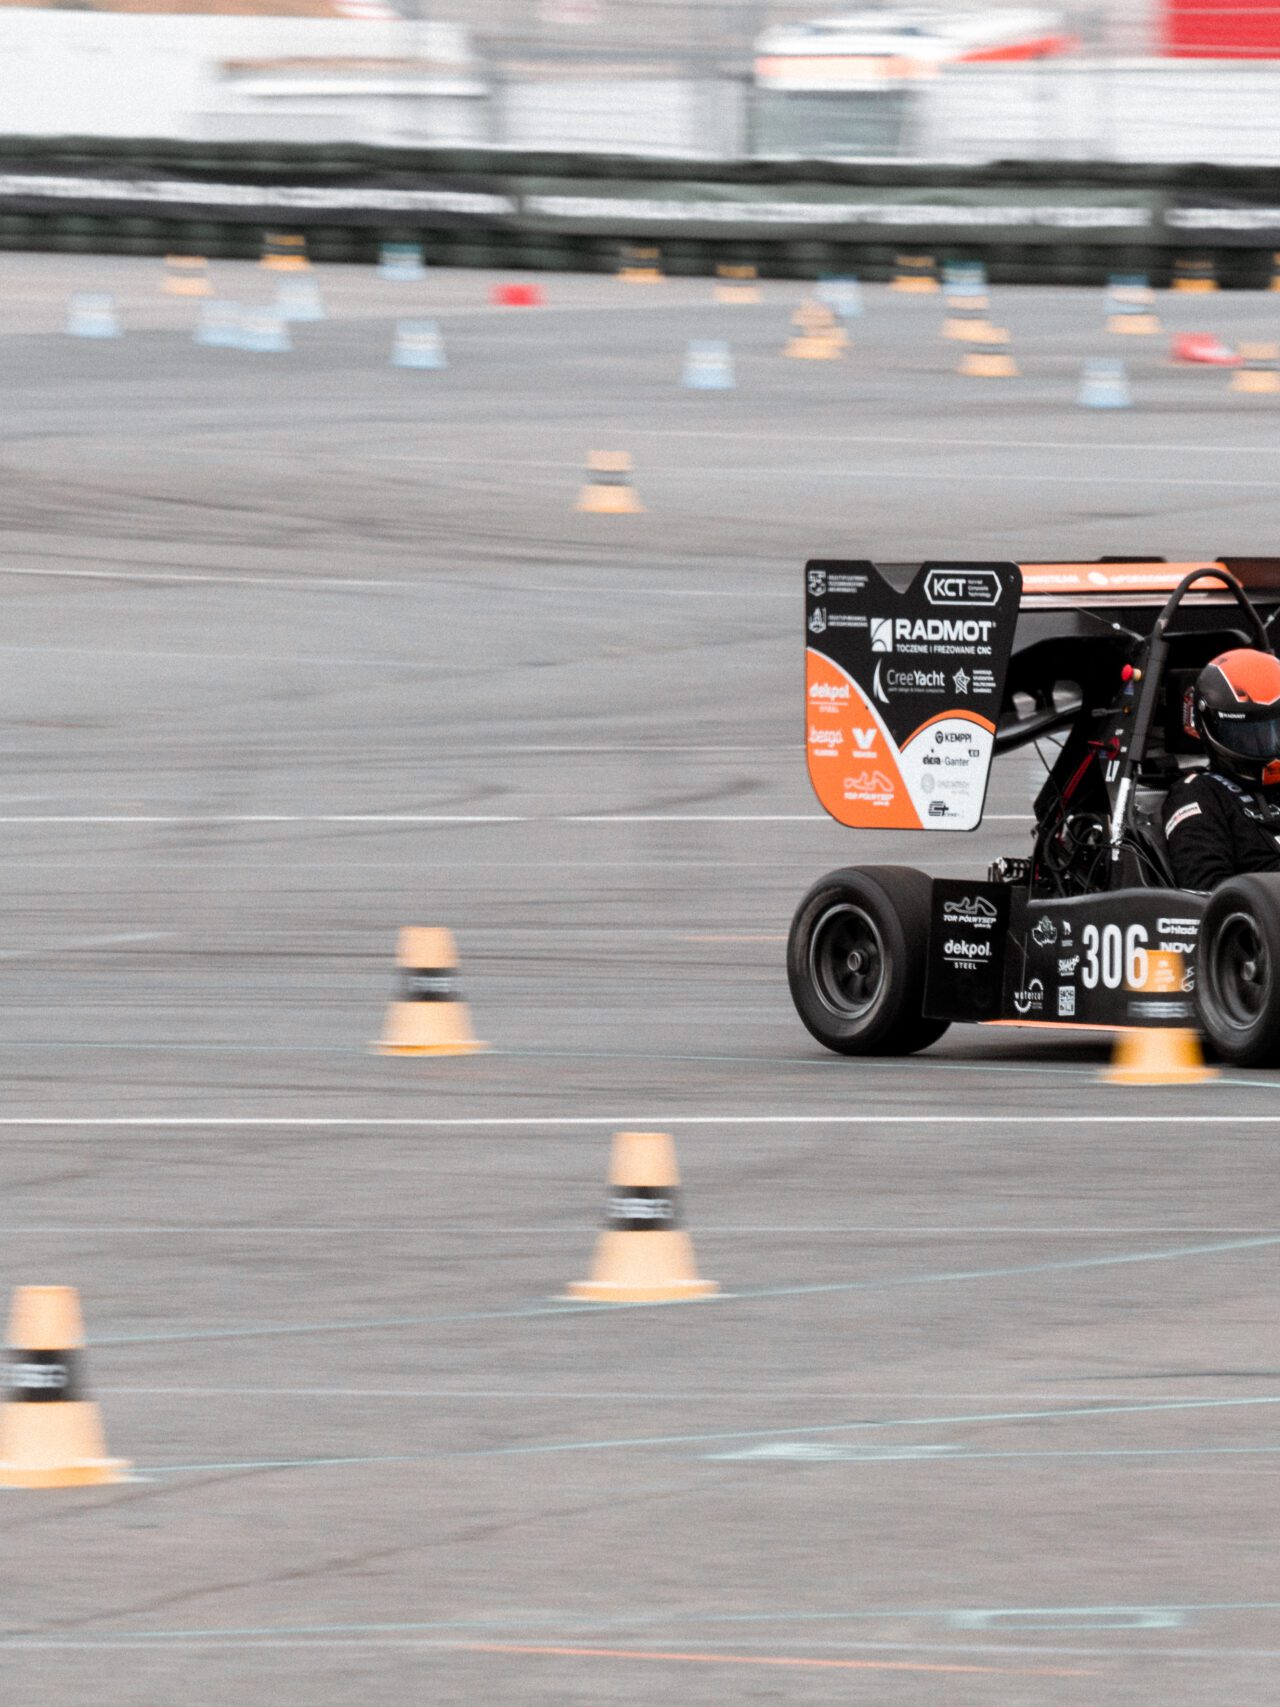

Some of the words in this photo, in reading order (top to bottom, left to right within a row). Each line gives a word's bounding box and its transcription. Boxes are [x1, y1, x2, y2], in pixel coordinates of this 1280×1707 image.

[933, 578, 967, 597] KCT
[895, 618, 993, 642] RADMOT
[896, 643, 929, 655] TOCZENIE
[933, 644, 976, 655] FREZOWANIE
[976, 645, 993, 656] CNC
[886, 669, 946, 687] CreeYacht
[944, 733, 973, 743] KEMPPI
[944, 939, 990, 958] dekpol
[1083, 924, 1149, 989] 306
[954, 962, 977, 970] STEEL
